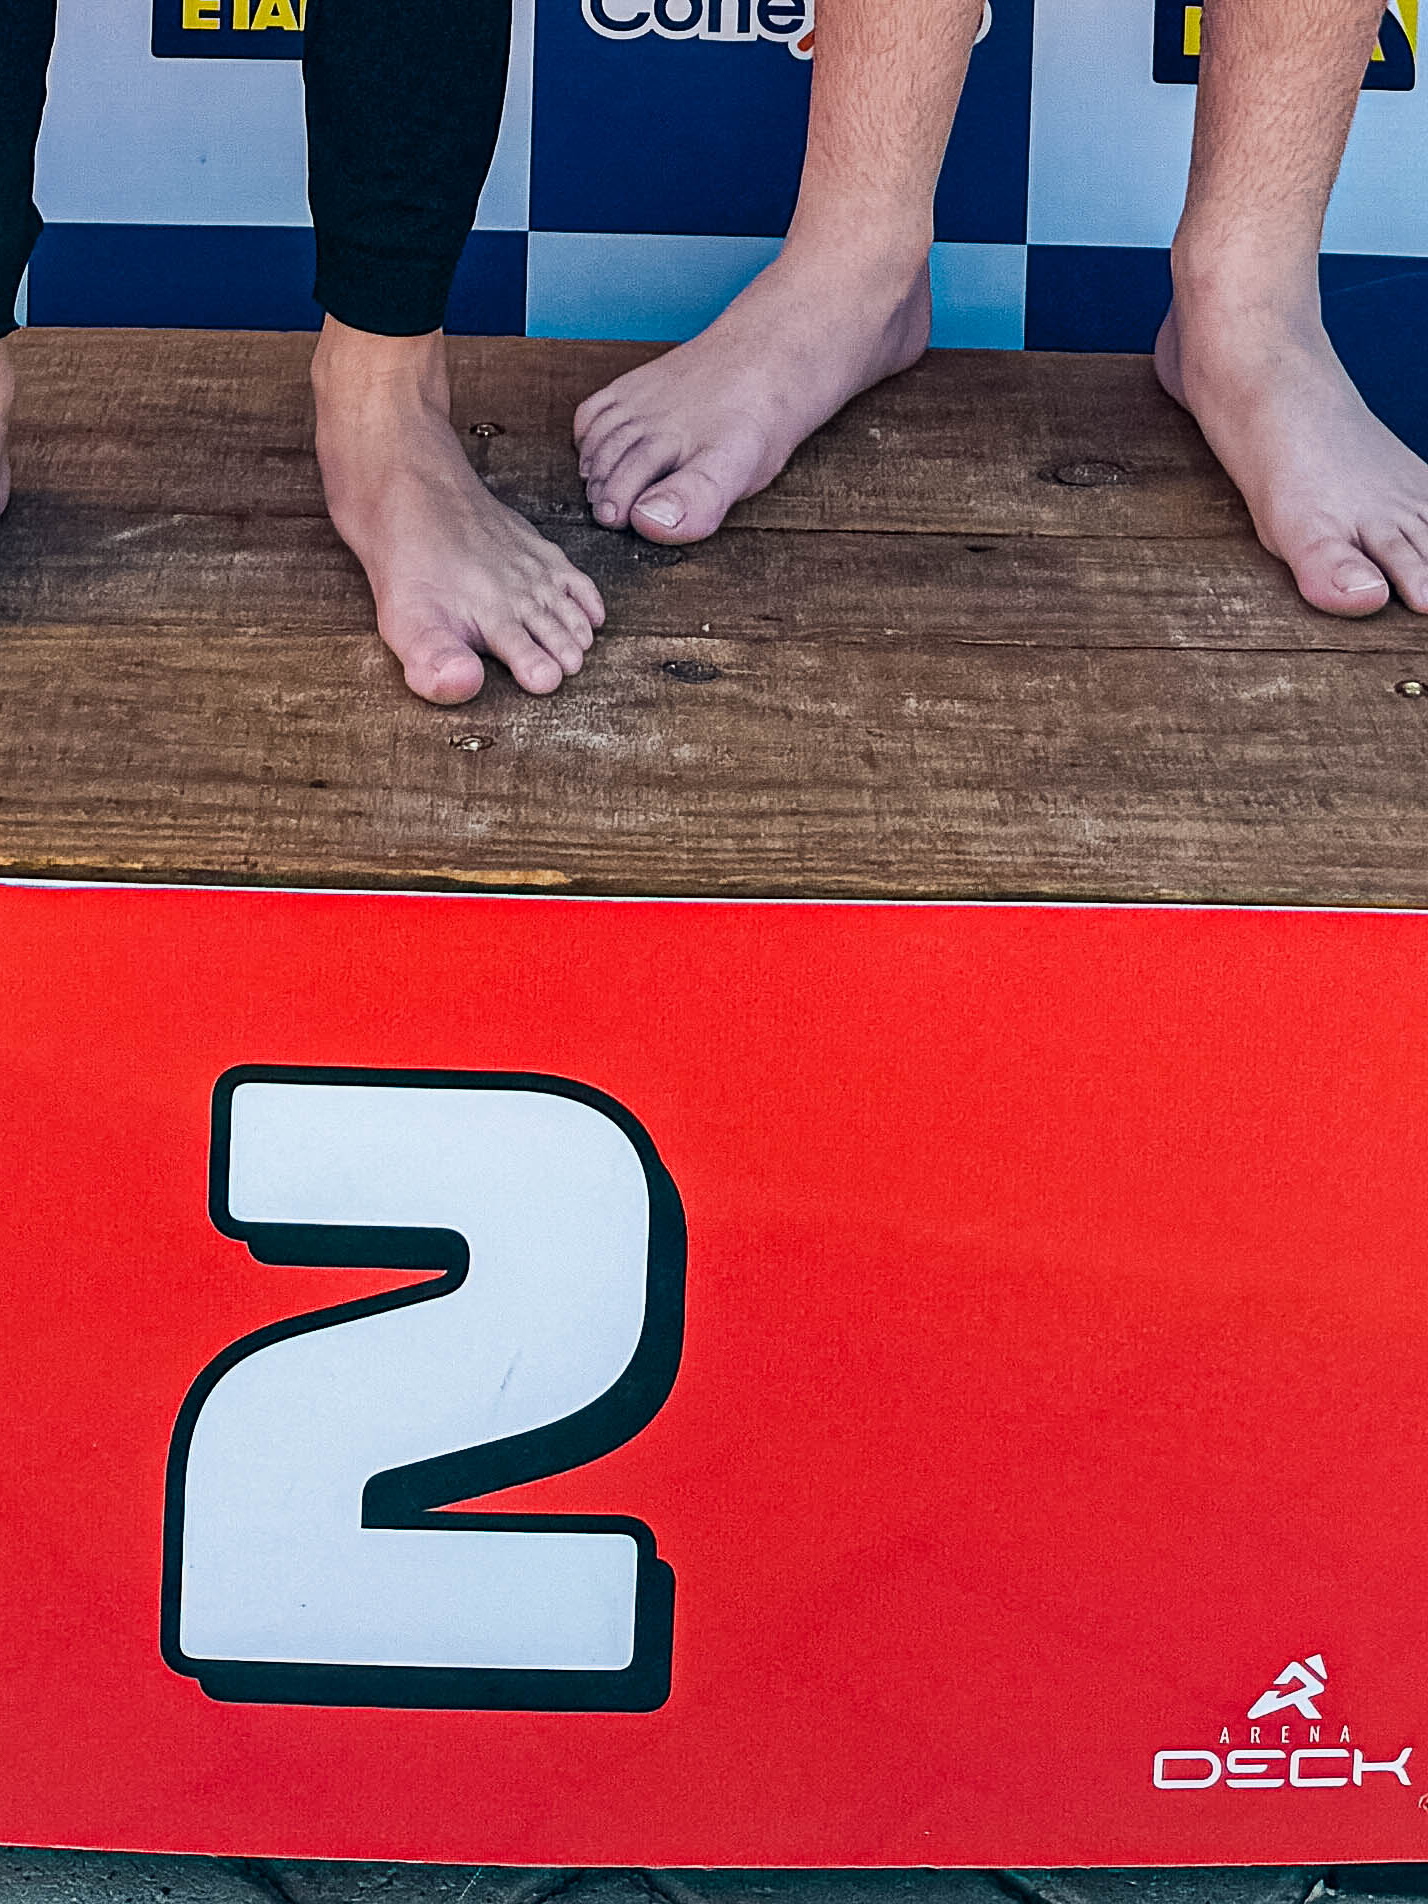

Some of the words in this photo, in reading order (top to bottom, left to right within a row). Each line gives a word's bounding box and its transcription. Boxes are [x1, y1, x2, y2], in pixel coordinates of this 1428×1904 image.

[160, 1063, 688, 1714] 2
[1218, 1724, 1351, 1744] ARENA
[1153, 1747, 1413, 1790] DECK
